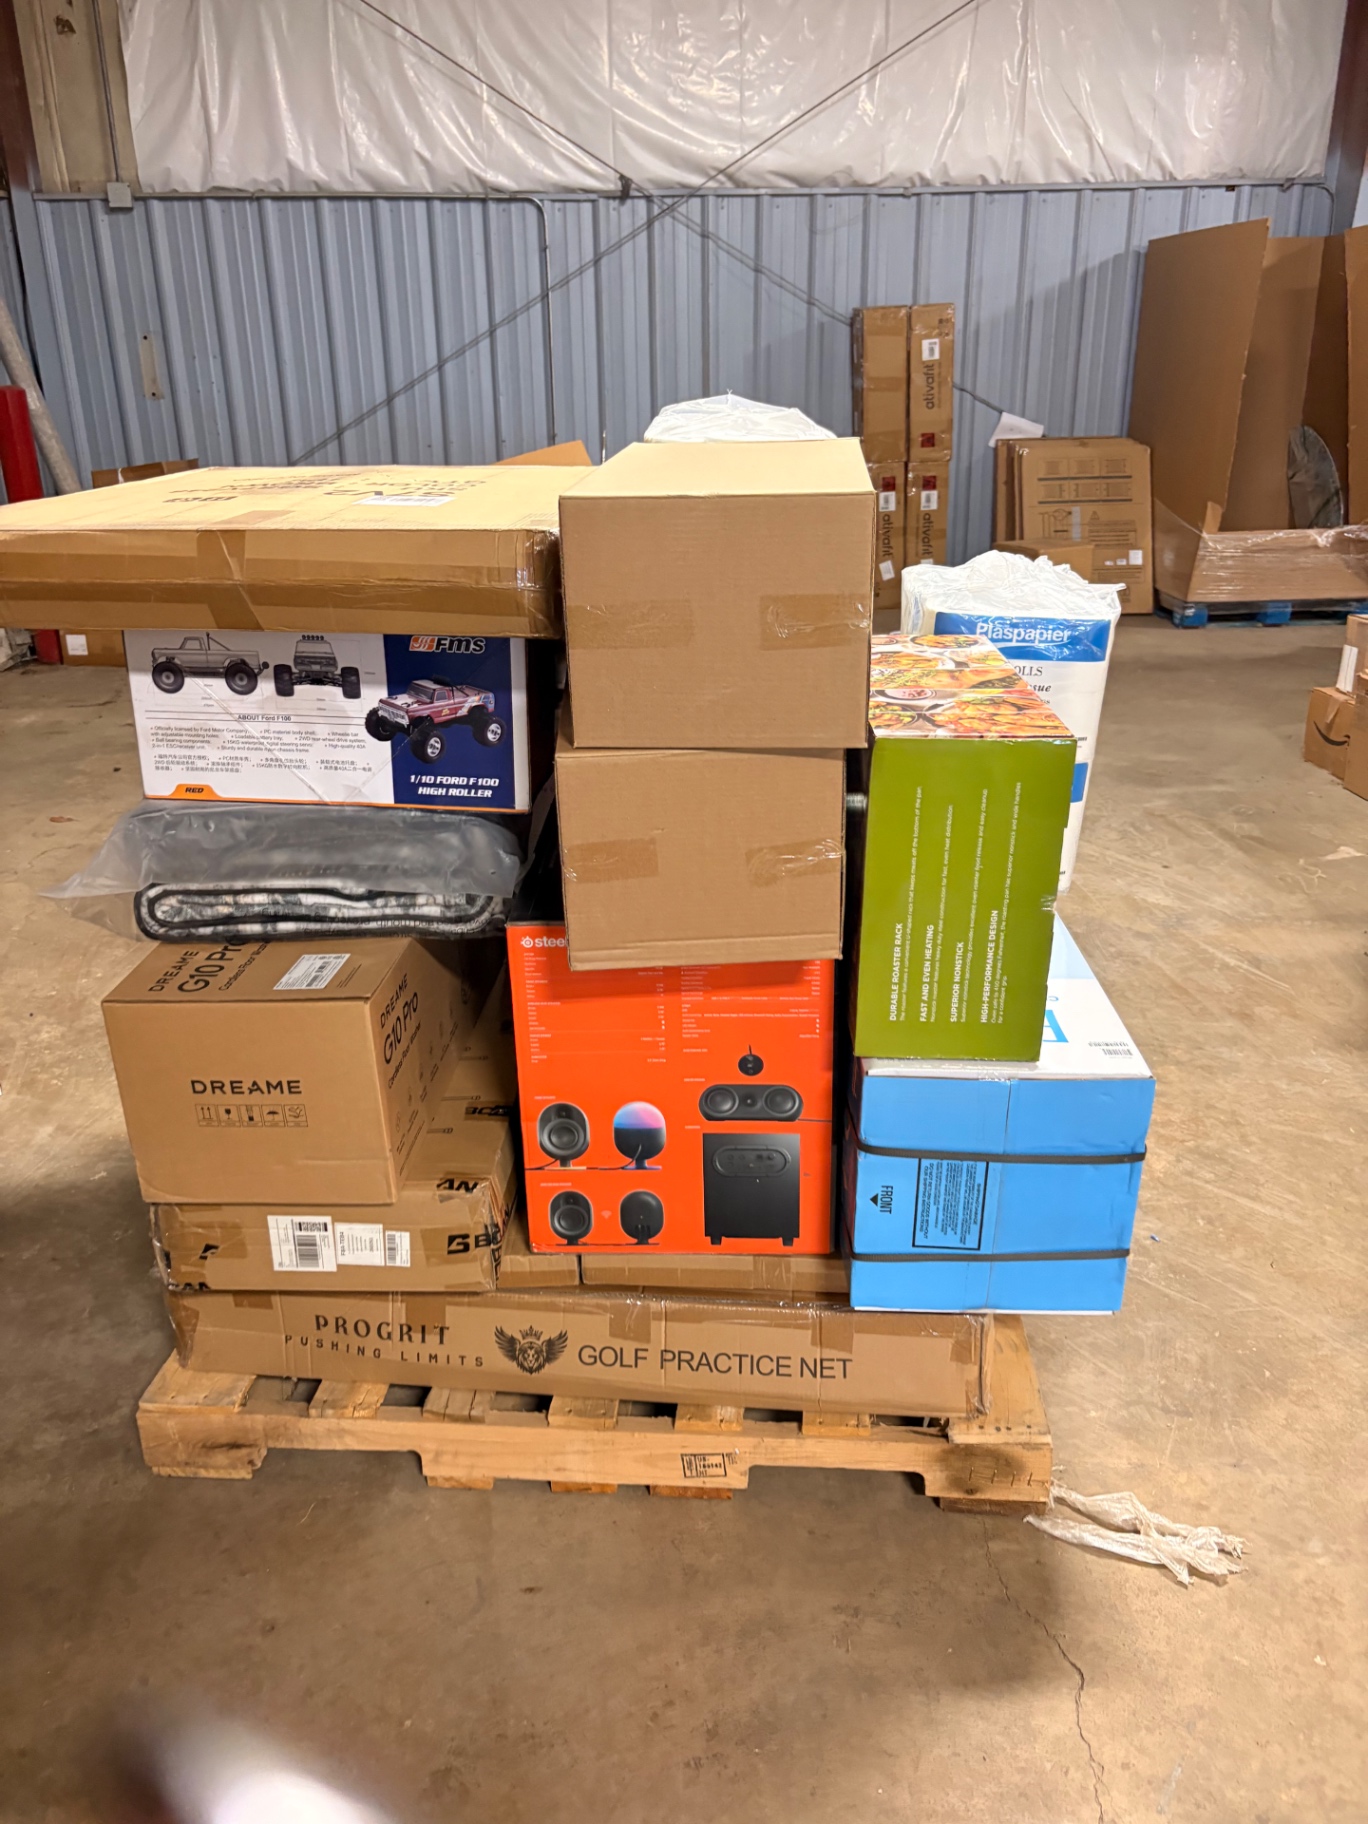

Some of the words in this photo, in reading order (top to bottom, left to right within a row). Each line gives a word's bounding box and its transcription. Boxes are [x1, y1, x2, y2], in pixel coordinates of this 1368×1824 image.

[925, 363, 935, 409] ativafit
[882, 514, 894, 557] ativafit
[976, 622, 1070, 644] Plaspapier
[1015, 665, 1042, 676] OLLS
[1030, 684, 1051, 693] sue
[184, 785, 205, 795] RED
[410, 774, 435, 784] 1/10
[436, 775, 467, 785] FORD
[418, 786, 446, 796] HIGH
[448, 788, 492, 797] ROLLER
[895, 923, 903, 945] RACK
[924, 924, 934, 959] HEATING
[148, 950, 199, 992] DREAME
[892, 947, 901, 983] ROASTER
[922, 961, 931, 982] EVEN
[953, 942, 964, 982] NONSTICK
[981, 942, 995, 1022] HIGH-PERFORMANCE
[988, 910, 999, 940] DESIGN
[177, 965, 224, 993] G10
[921, 984, 929, 1001] AND
[380, 973, 409, 1029] DREAME
[890, 984, 899, 1021] DURABLE
[920, 1003, 928, 1021] FAST
[950, 984, 960, 1022] SUPERIOR
[383, 1016, 402, 1065] G10
[402, 992, 419, 1033] Pro
[190, 1079, 302, 1095] DREAME
[879, 1185, 893, 1214] FRONT
[315, 1315, 449, 1344] PROGRIT
[285, 1334, 381, 1358] PUSHING
[401, 1351, 483, 1367] LIMITS
[578, 1345, 649, 1368] GOLF
[660, 1349, 792, 1377] PRACTICE
[800, 1357, 853, 1379] NET
